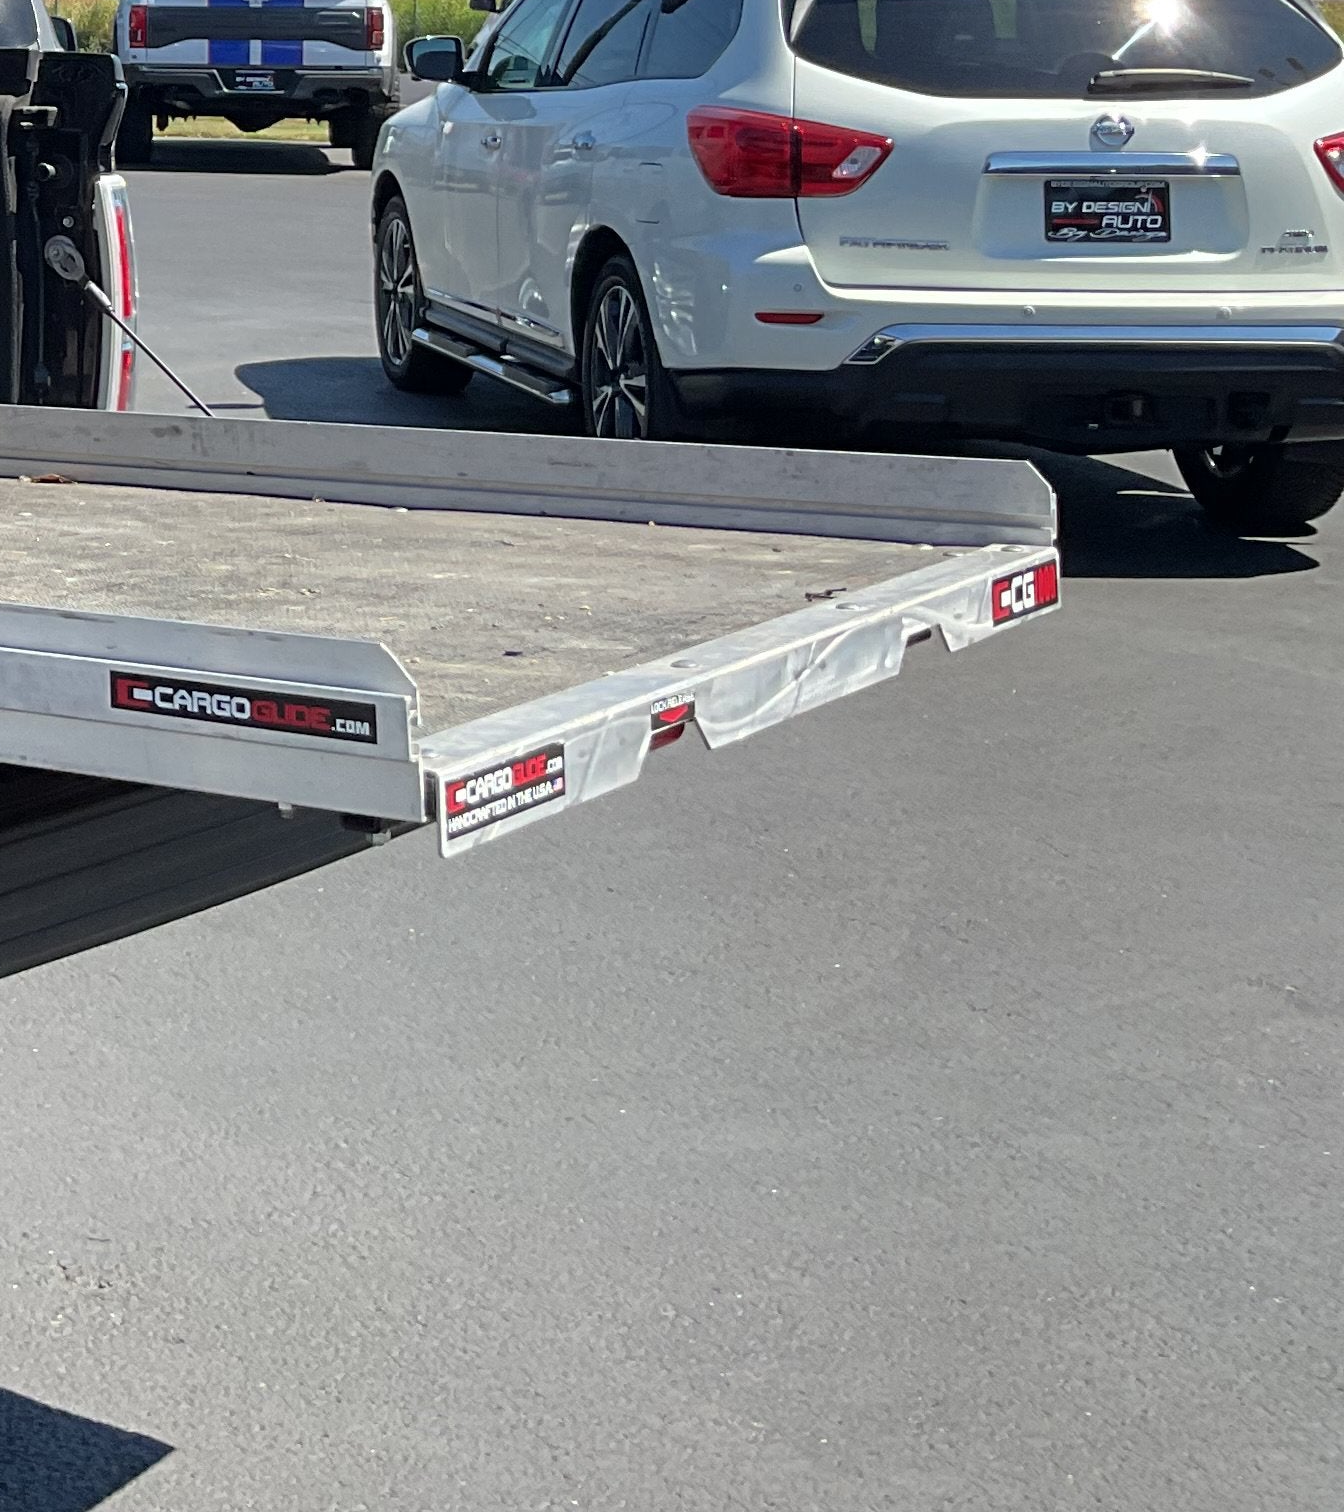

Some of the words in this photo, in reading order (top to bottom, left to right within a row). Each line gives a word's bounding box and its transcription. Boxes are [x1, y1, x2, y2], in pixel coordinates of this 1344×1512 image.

[1051, 201, 1078, 213] BY
[1081, 201, 1151, 213] DESIGN
[1101, 215, 1163, 228] AUTO
[1047, 228, 1088, 242] By
[447, 798, 507, 833] HANDCRAFTED
[507, 796, 517, 810] IN
[516, 787, 533, 806] THE
[532, 780, 553, 800] USA
